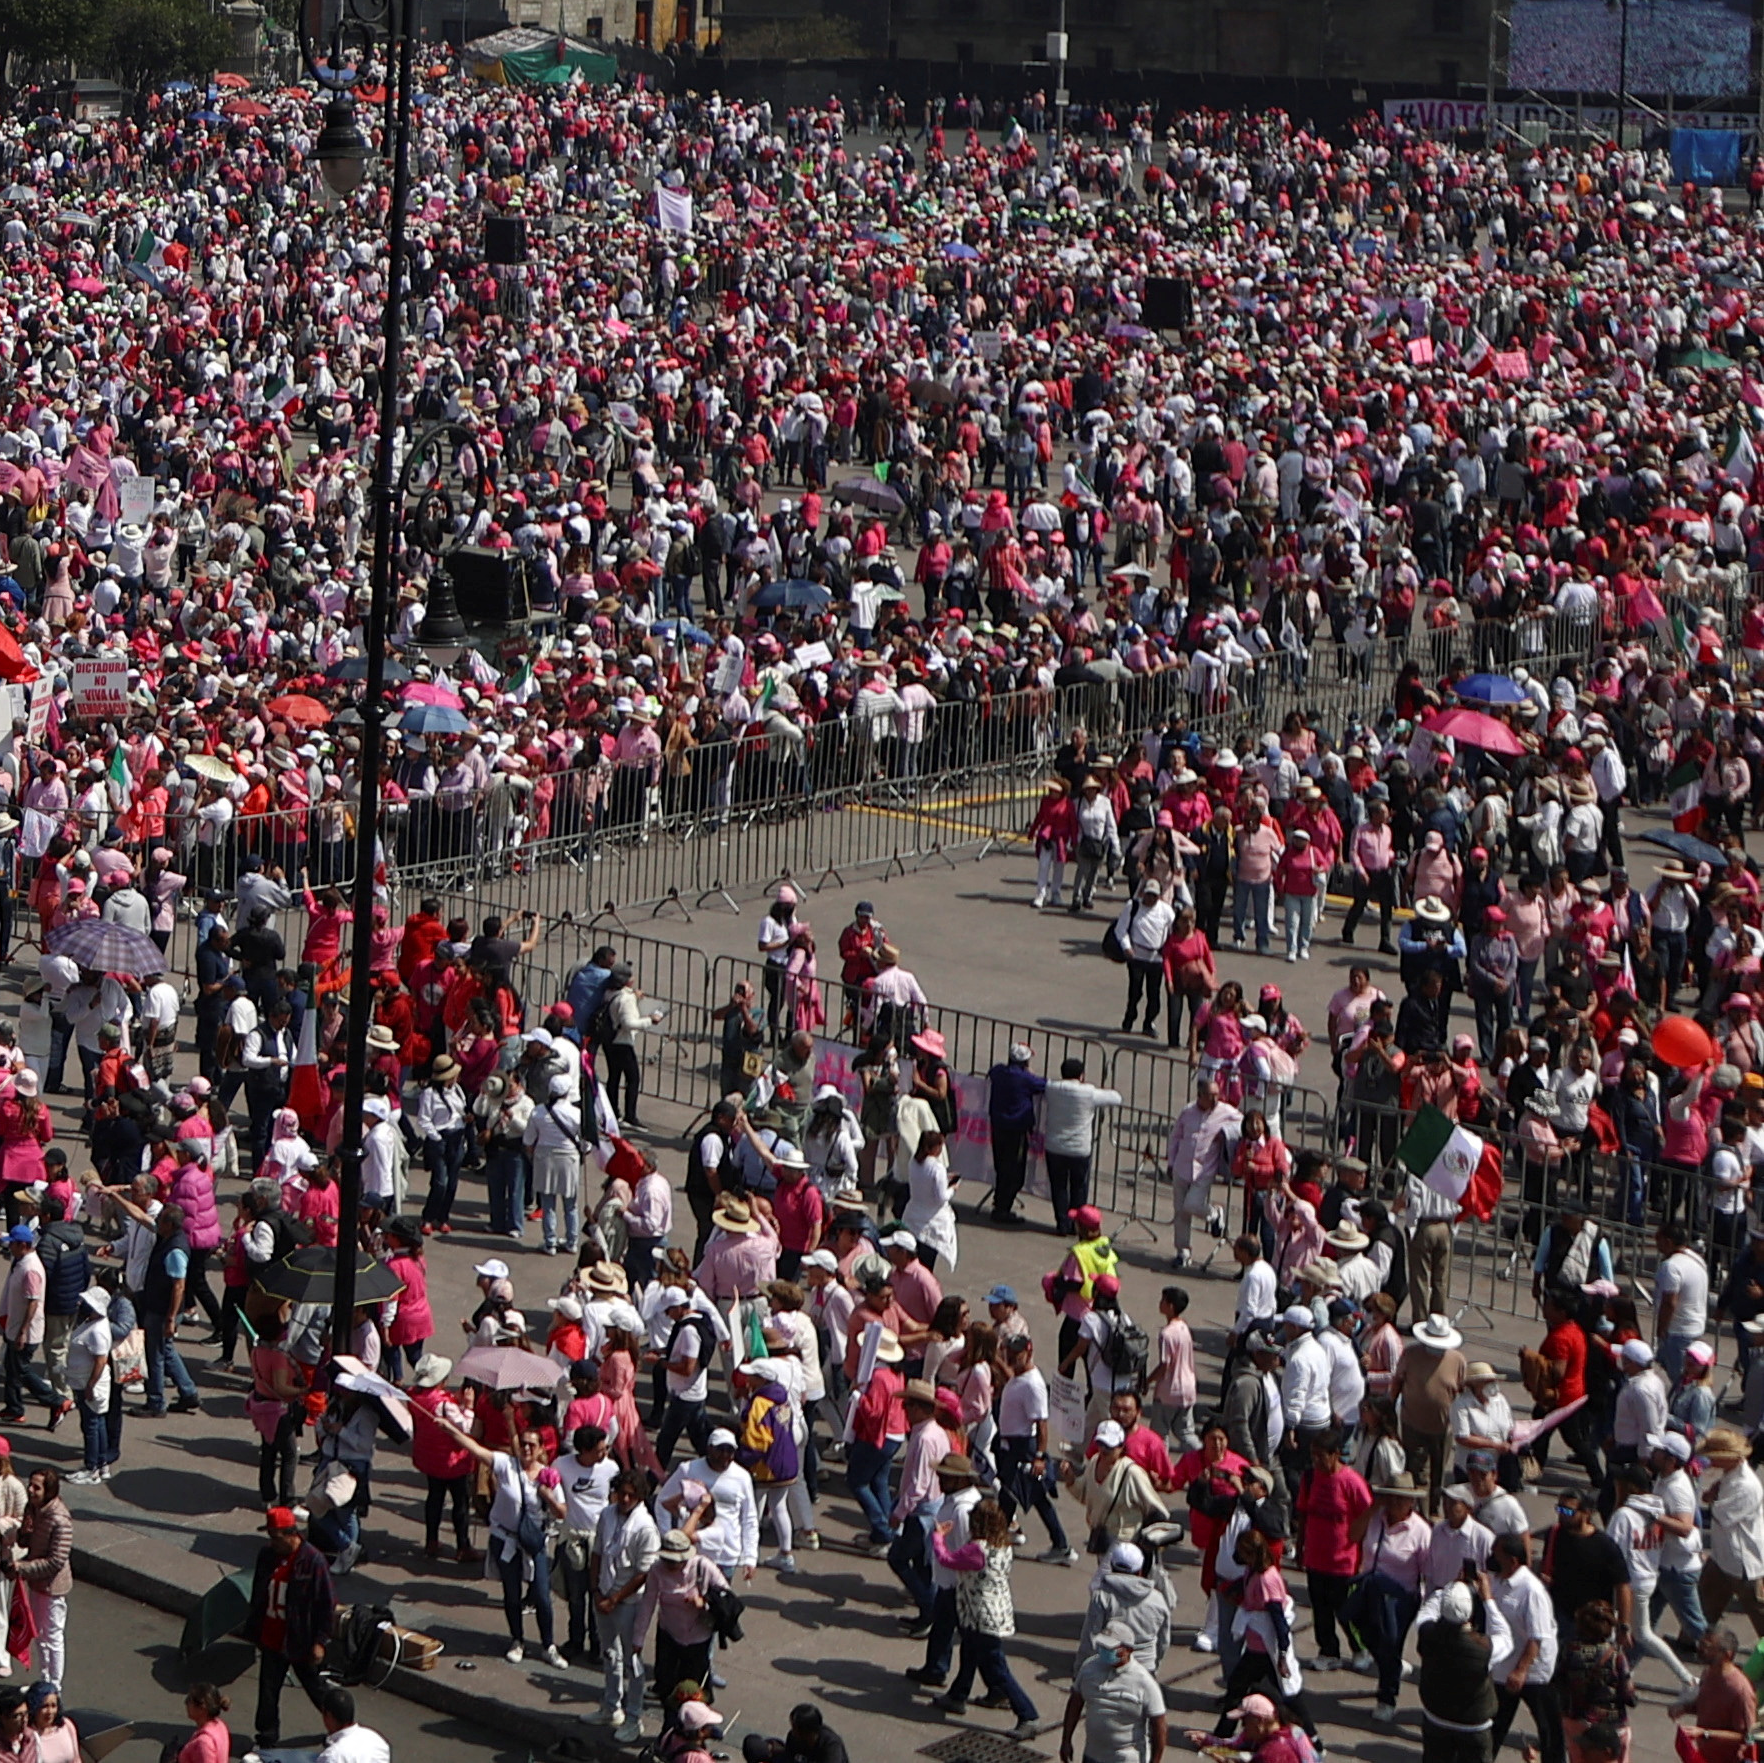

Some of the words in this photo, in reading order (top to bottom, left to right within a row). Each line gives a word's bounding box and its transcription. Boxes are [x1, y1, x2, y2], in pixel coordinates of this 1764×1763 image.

[75, 662, 127, 673] DICTADURA
[94, 676, 107, 685] NO
[108, 689, 121, 701] LA
